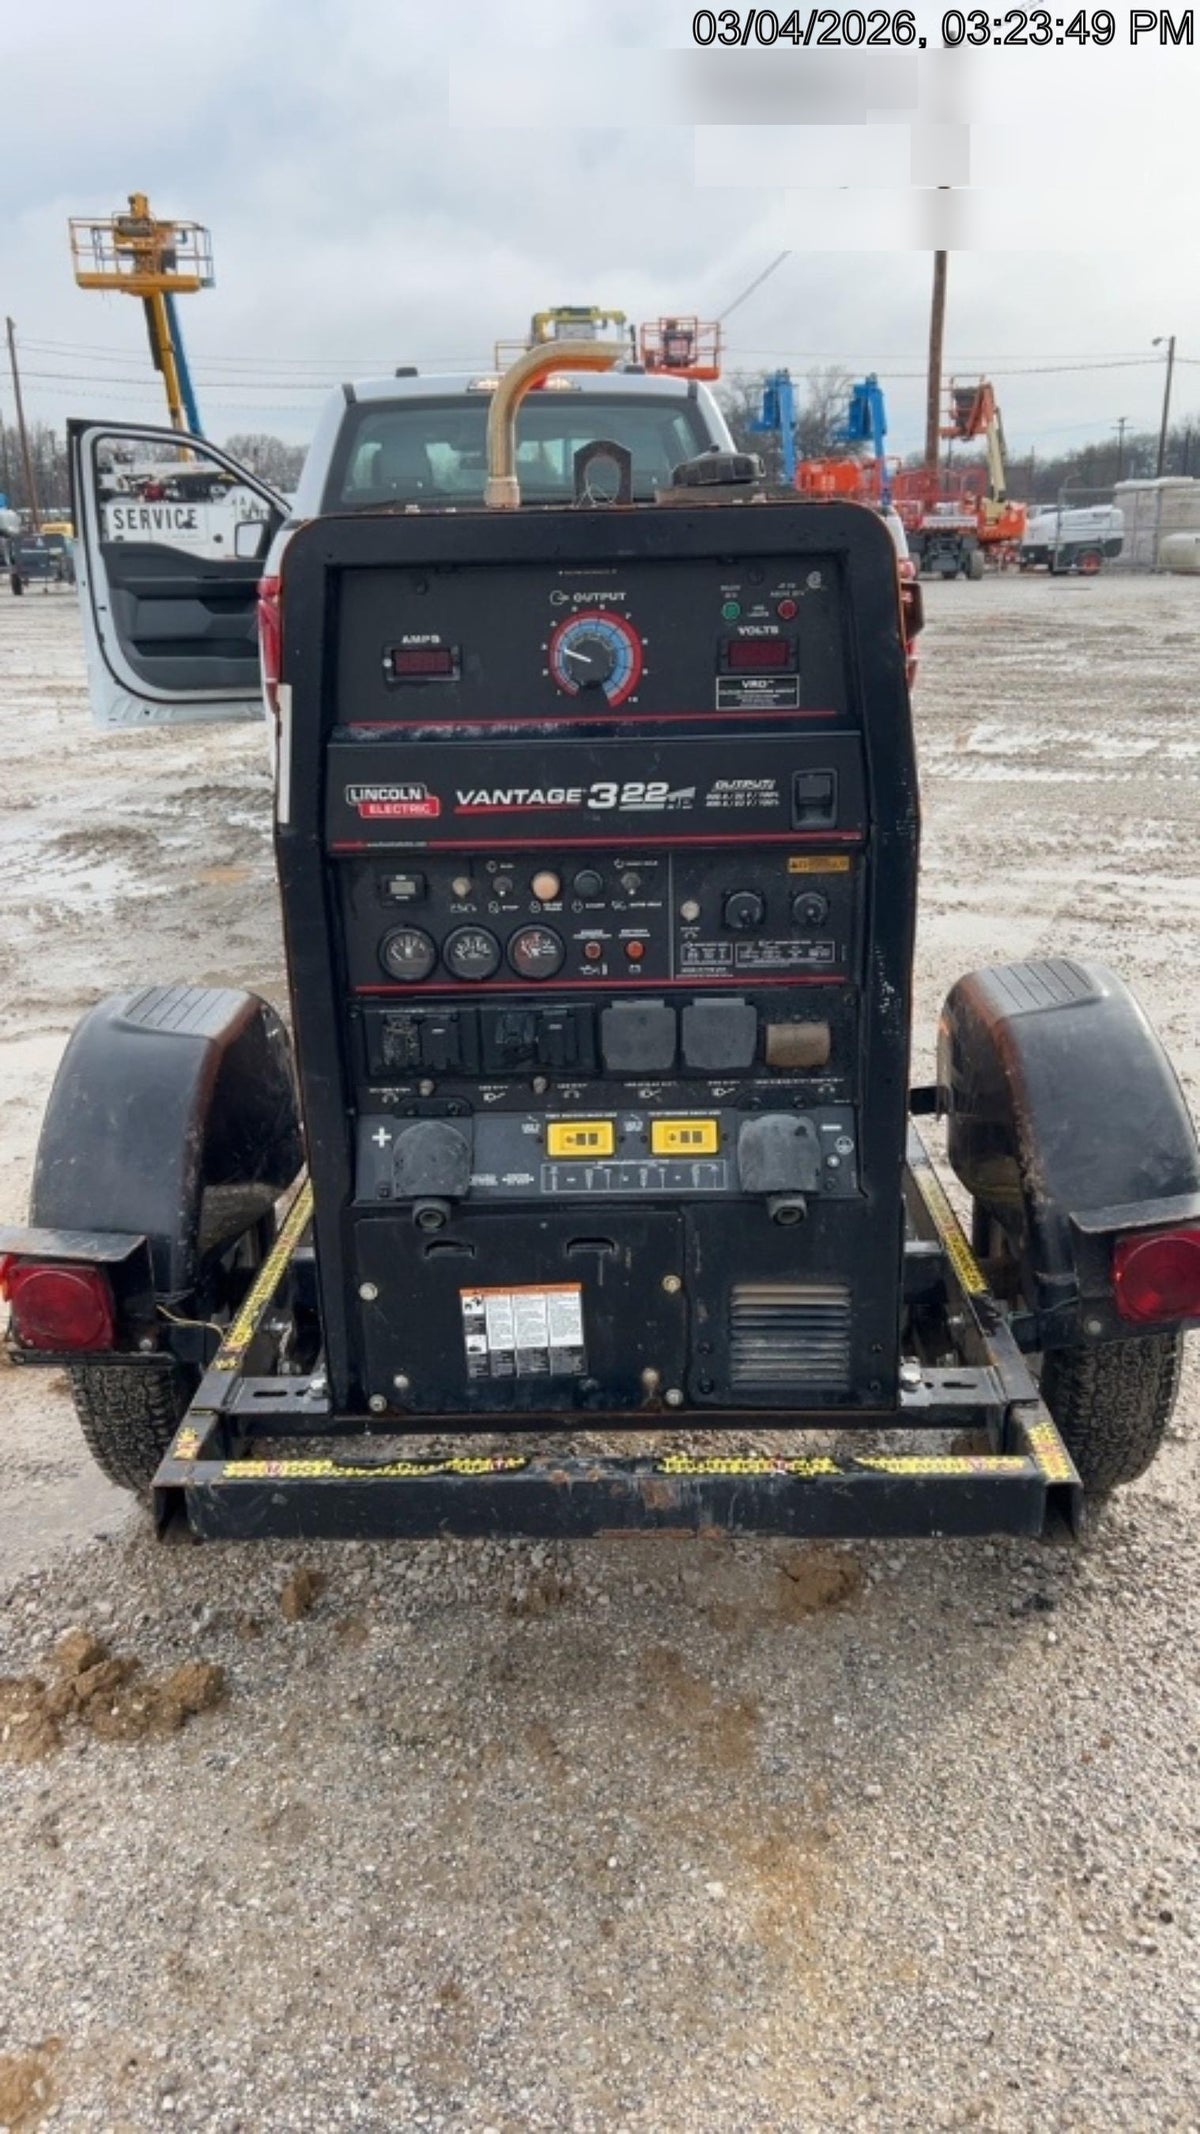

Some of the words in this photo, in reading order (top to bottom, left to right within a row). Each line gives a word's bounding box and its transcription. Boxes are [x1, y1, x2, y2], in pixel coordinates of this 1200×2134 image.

[113, 508, 198, 530] SERVICE
[573, 592, 627, 603] OUTPUT
[737, 625, 779, 636] VOLTS
[402, 634, 441, 644] AMPS
[350, 788, 421, 801] LINCOLN
[456, 789, 582, 805] VANTAGE
[587, 781, 670, 809] 322
[369, 803, 431, 815] ELECTRIC
